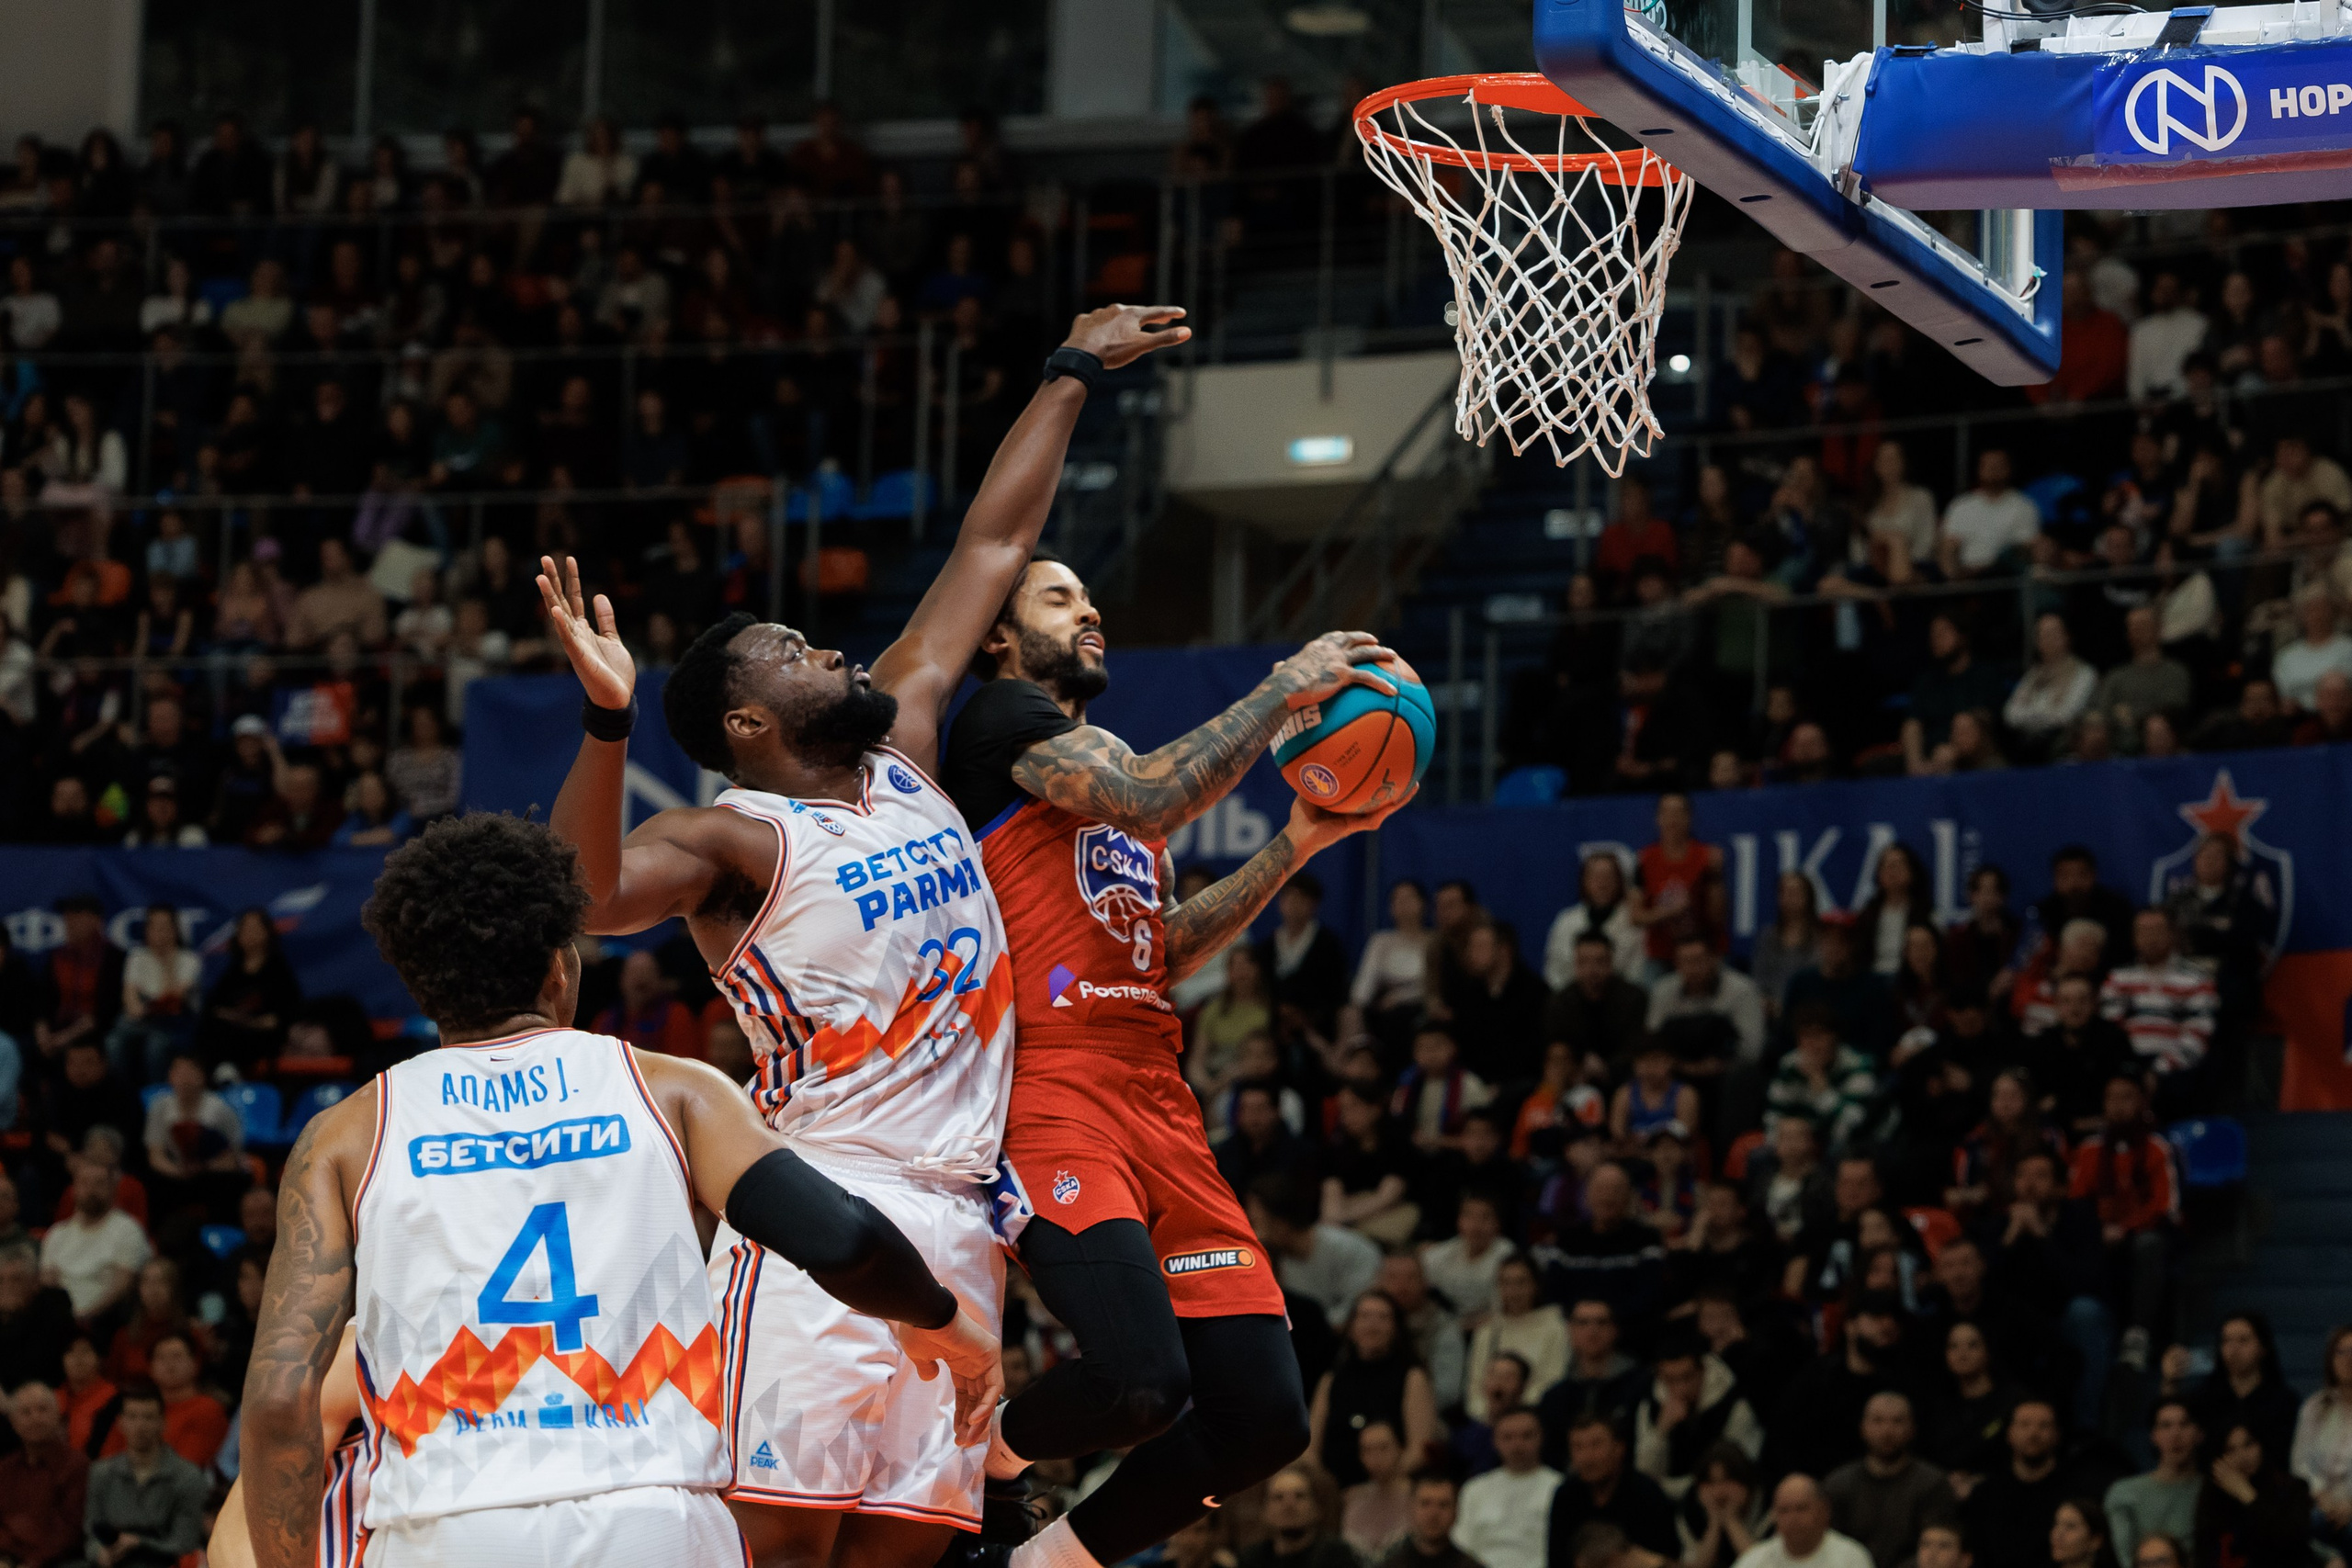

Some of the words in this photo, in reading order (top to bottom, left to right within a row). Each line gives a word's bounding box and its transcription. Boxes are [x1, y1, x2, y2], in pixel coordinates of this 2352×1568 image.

[835, 827, 964, 893] BETCITY
[1091, 845, 1151, 886] CSKA
[916, 926, 981, 1003] 32
[1132, 919, 1152, 971] 6
[442, 1065, 548, 1113] ADAMS
[556, 1057, 580, 1103] J.
[417, 1121, 620, 1168] БЕТСИТИ
[1056, 1179, 1077, 1196] CSKA
[477, 1201, 600, 1352] 4
[1169, 1251, 1237, 1273] WINLINE
[750, 1455, 780, 1471] PEAK
